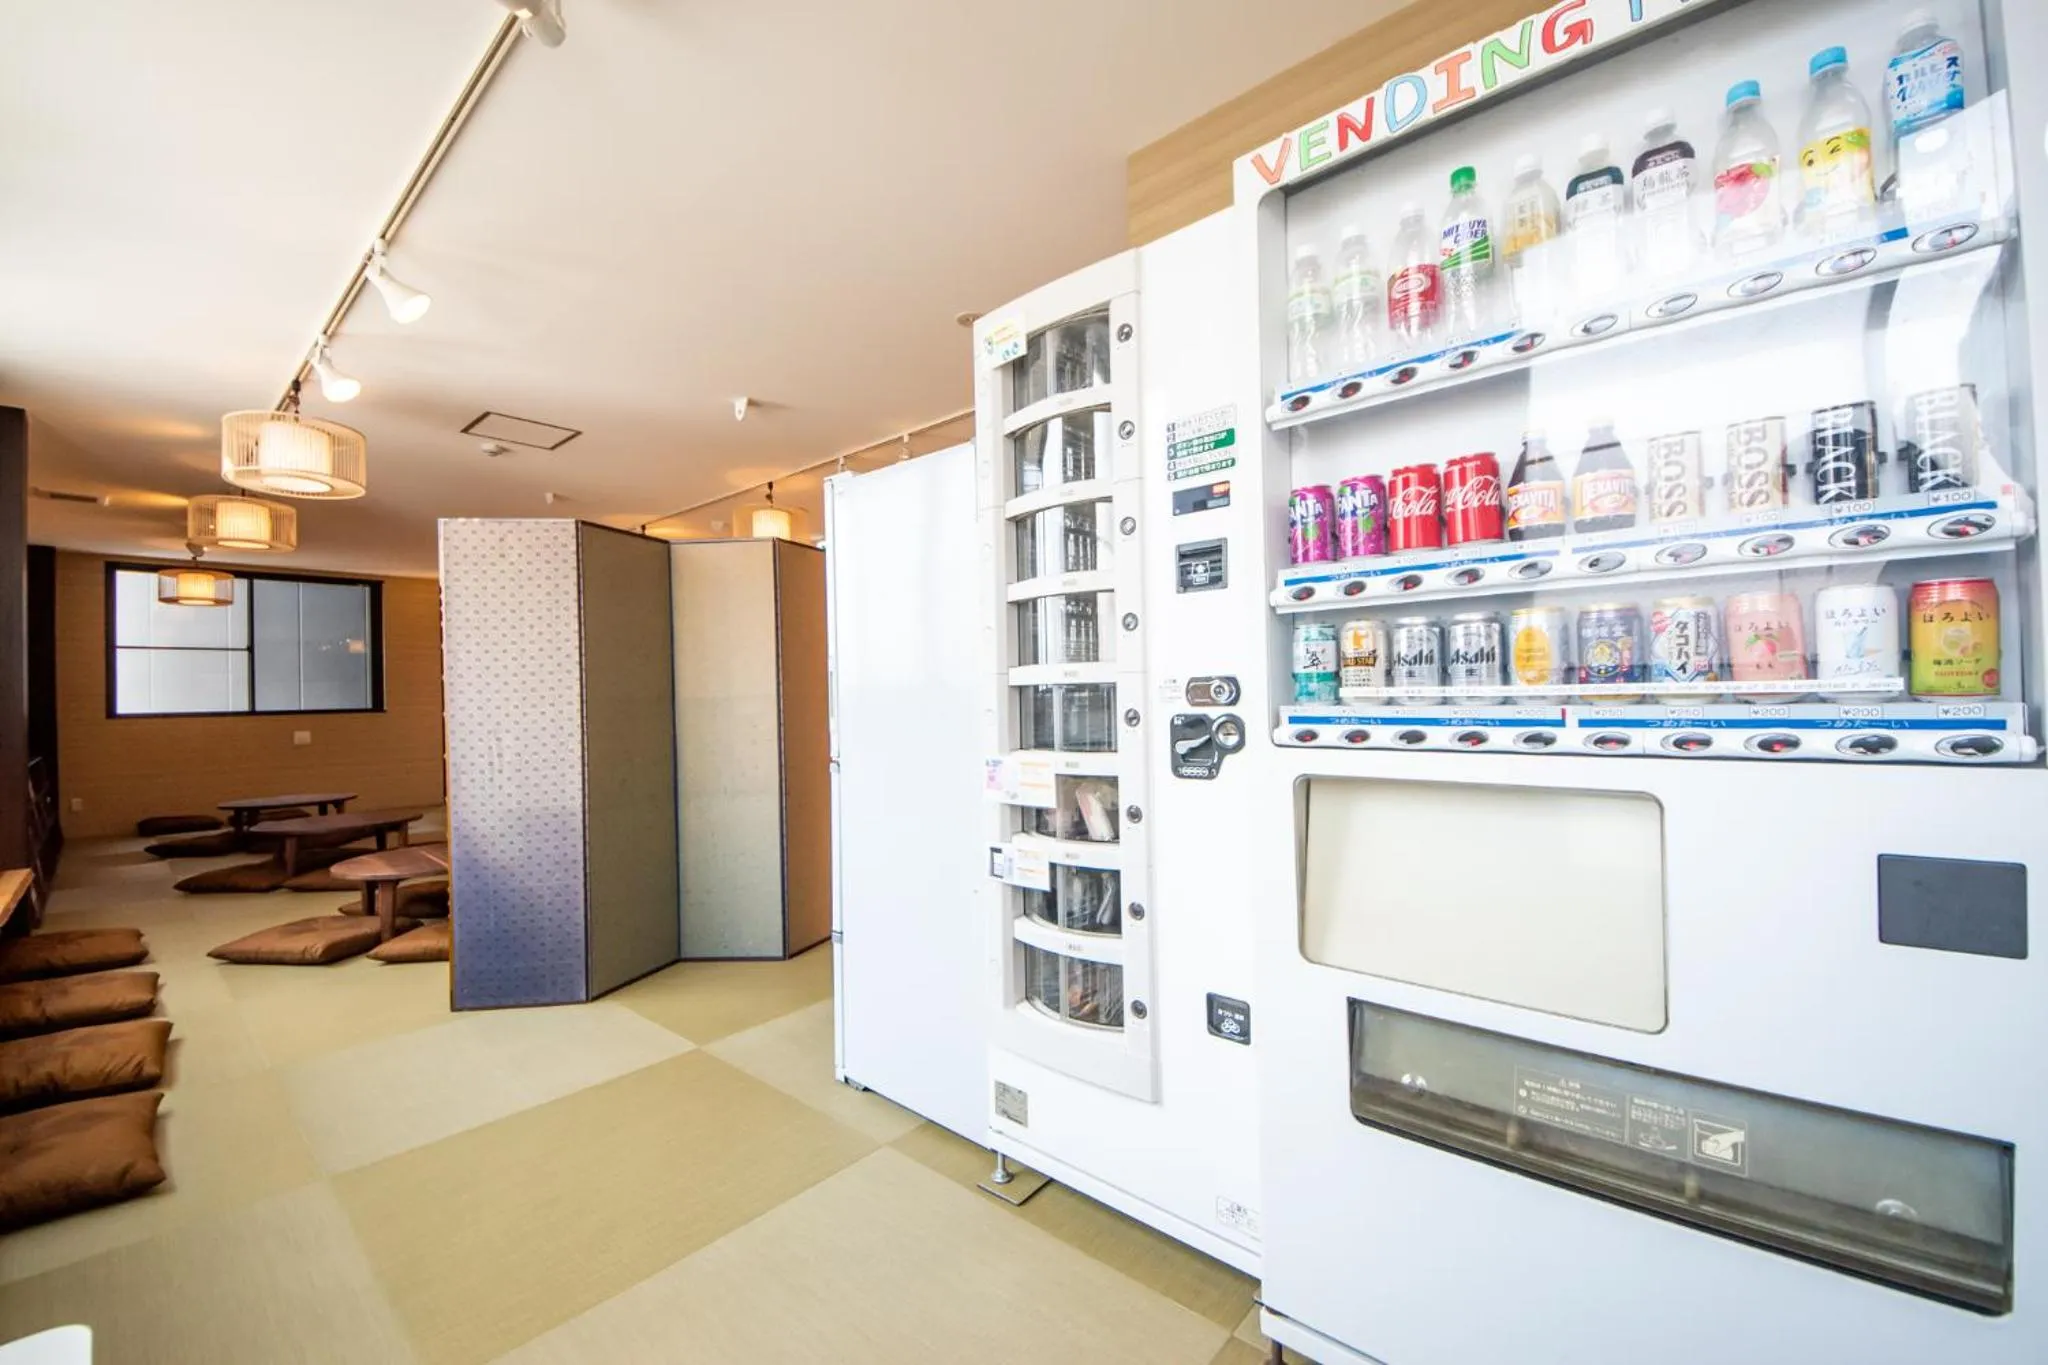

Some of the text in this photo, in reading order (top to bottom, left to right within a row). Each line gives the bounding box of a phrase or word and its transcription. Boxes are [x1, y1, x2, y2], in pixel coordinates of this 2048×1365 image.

[1250, 0, 1594, 185] VENDING
[1442, 218, 1488, 239] MITUYA
[1453, 229, 1488, 245] CDER
[1917, 391, 1963, 493] BLACK
[1736, 422, 1770, 508] BOSS
[1816, 407, 1856, 504] BLACK
[1656, 438, 1688, 519] BOSS
[1289, 499, 1324, 518] ANTA
[1338, 489, 1379, 511] ANTA
[1923, 611, 1991, 624] ほろよい
[1675, 620, 1691, 674] タコハイ
[1751, 706, 1787, 717] ¥200
[1842, 707, 1880, 717] ¥200
[1942, 706, 1981, 716] ¥200
